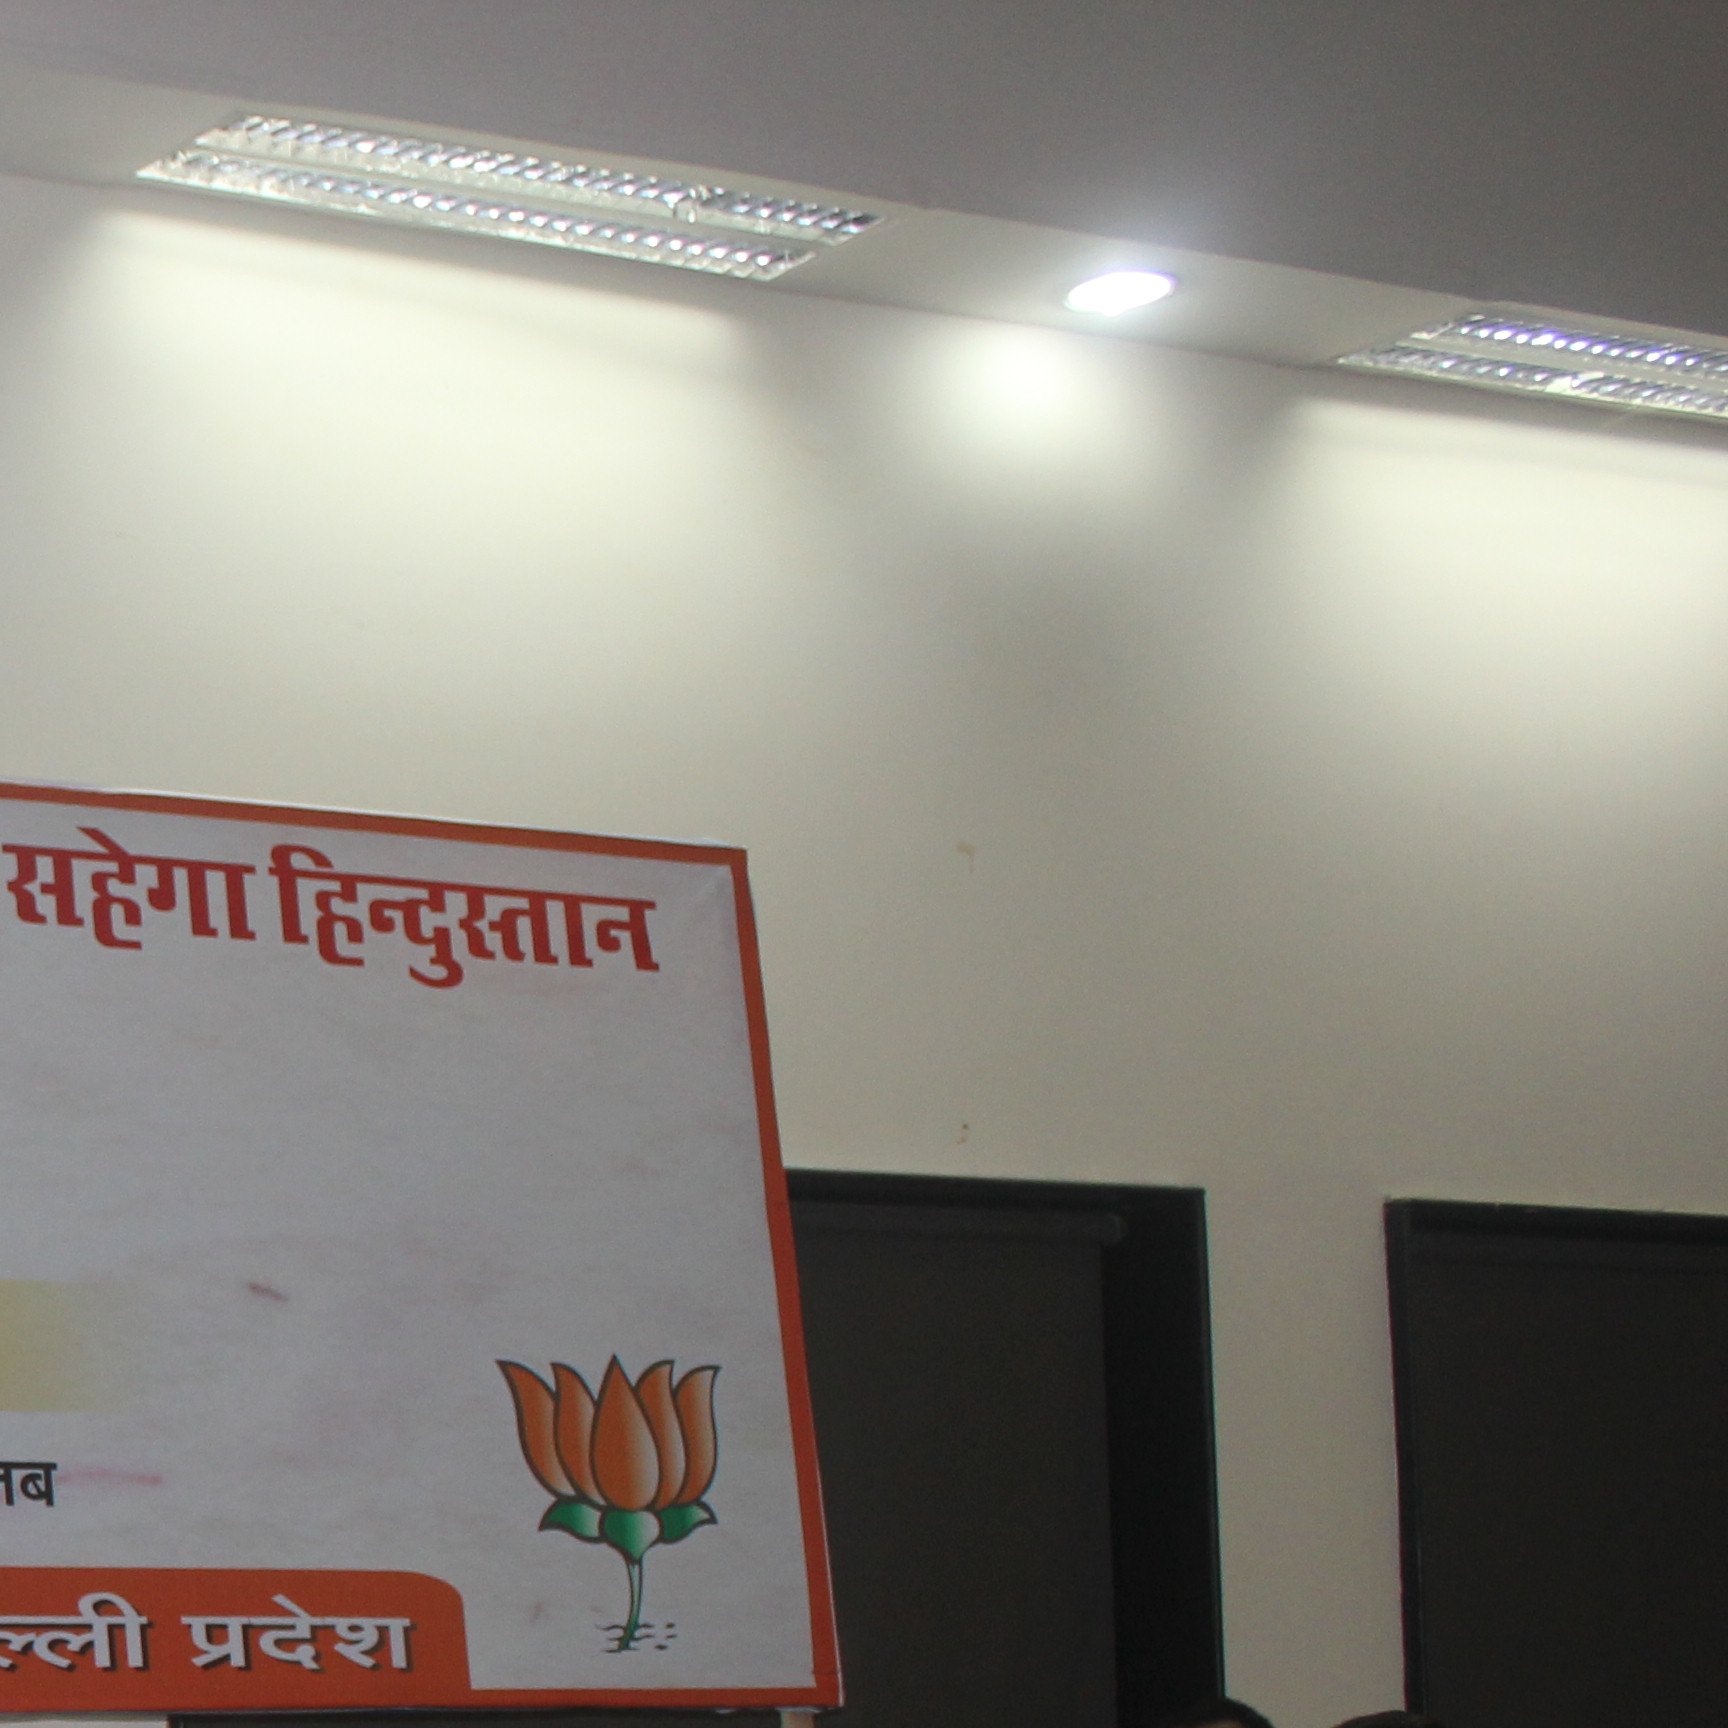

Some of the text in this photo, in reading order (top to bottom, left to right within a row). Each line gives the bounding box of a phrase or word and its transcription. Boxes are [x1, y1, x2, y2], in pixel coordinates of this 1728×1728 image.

[2, 826, 255, 950] सहेगा
[269, 844, 659, 988] हिन्दुस्तान
[180, 1594, 412, 1670] प्रदेश
